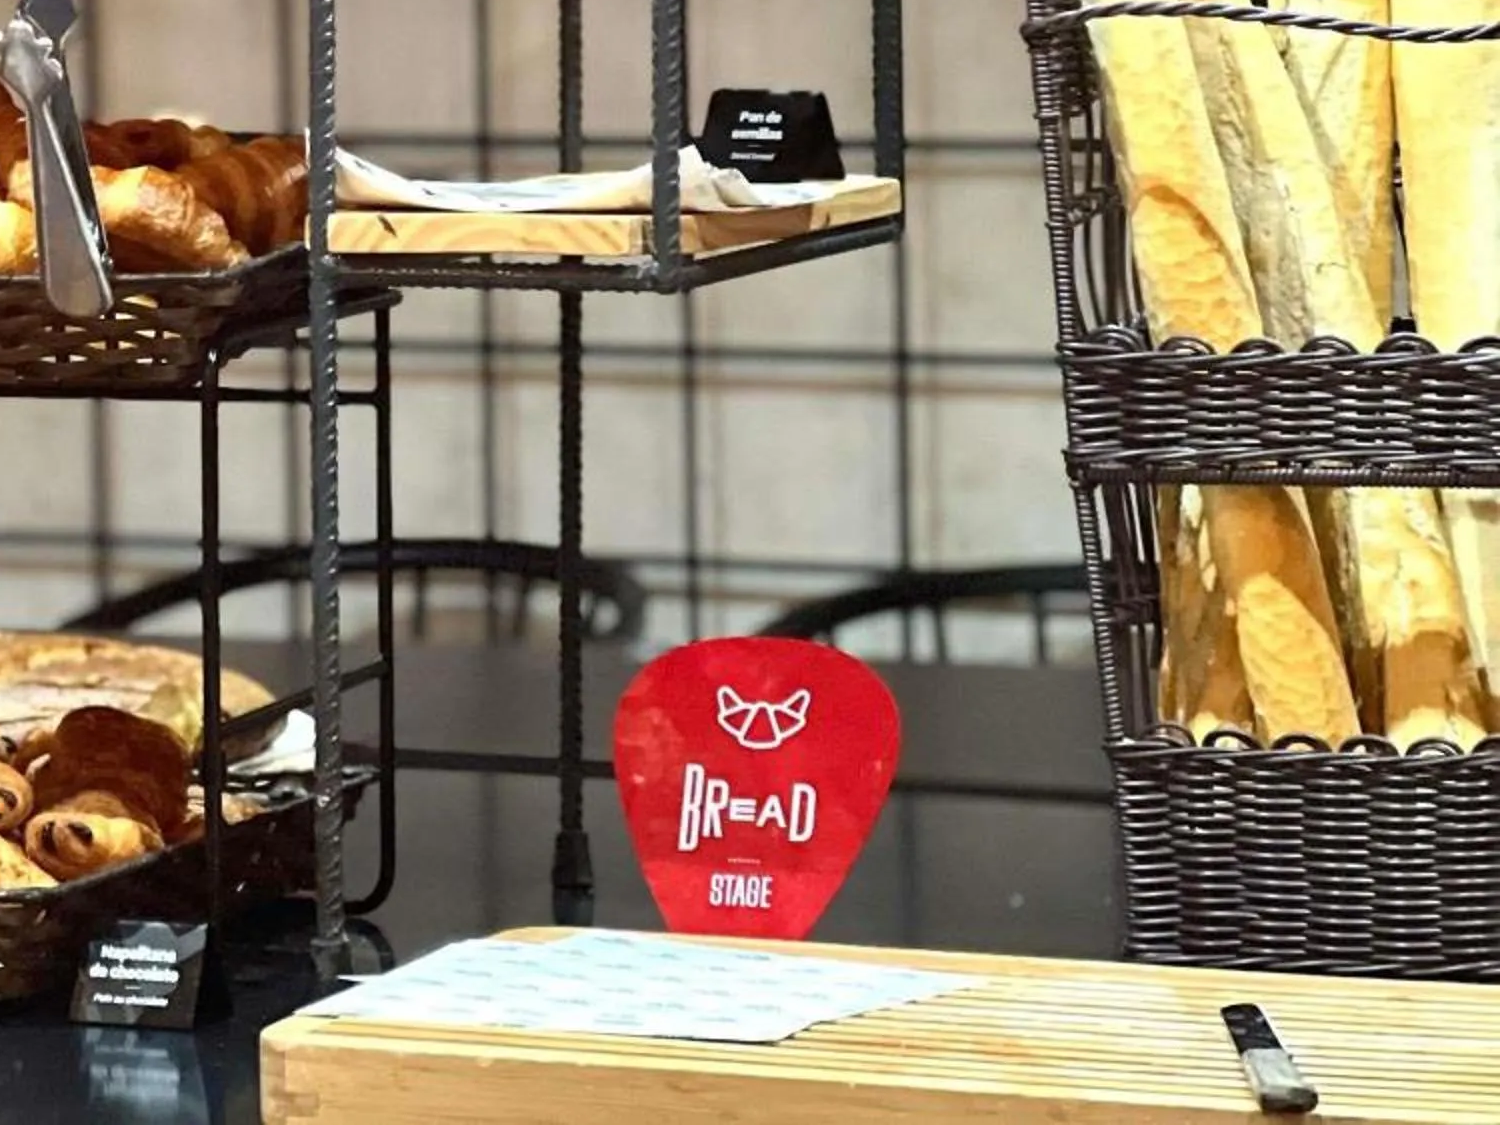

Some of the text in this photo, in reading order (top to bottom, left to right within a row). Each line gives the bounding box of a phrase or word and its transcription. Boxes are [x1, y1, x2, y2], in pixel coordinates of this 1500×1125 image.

[739, 111, 764, 123] Pan
[678, 763, 817, 852] BREAD
[709, 874, 773, 908] STAGE
[89, 962, 108, 978] de
